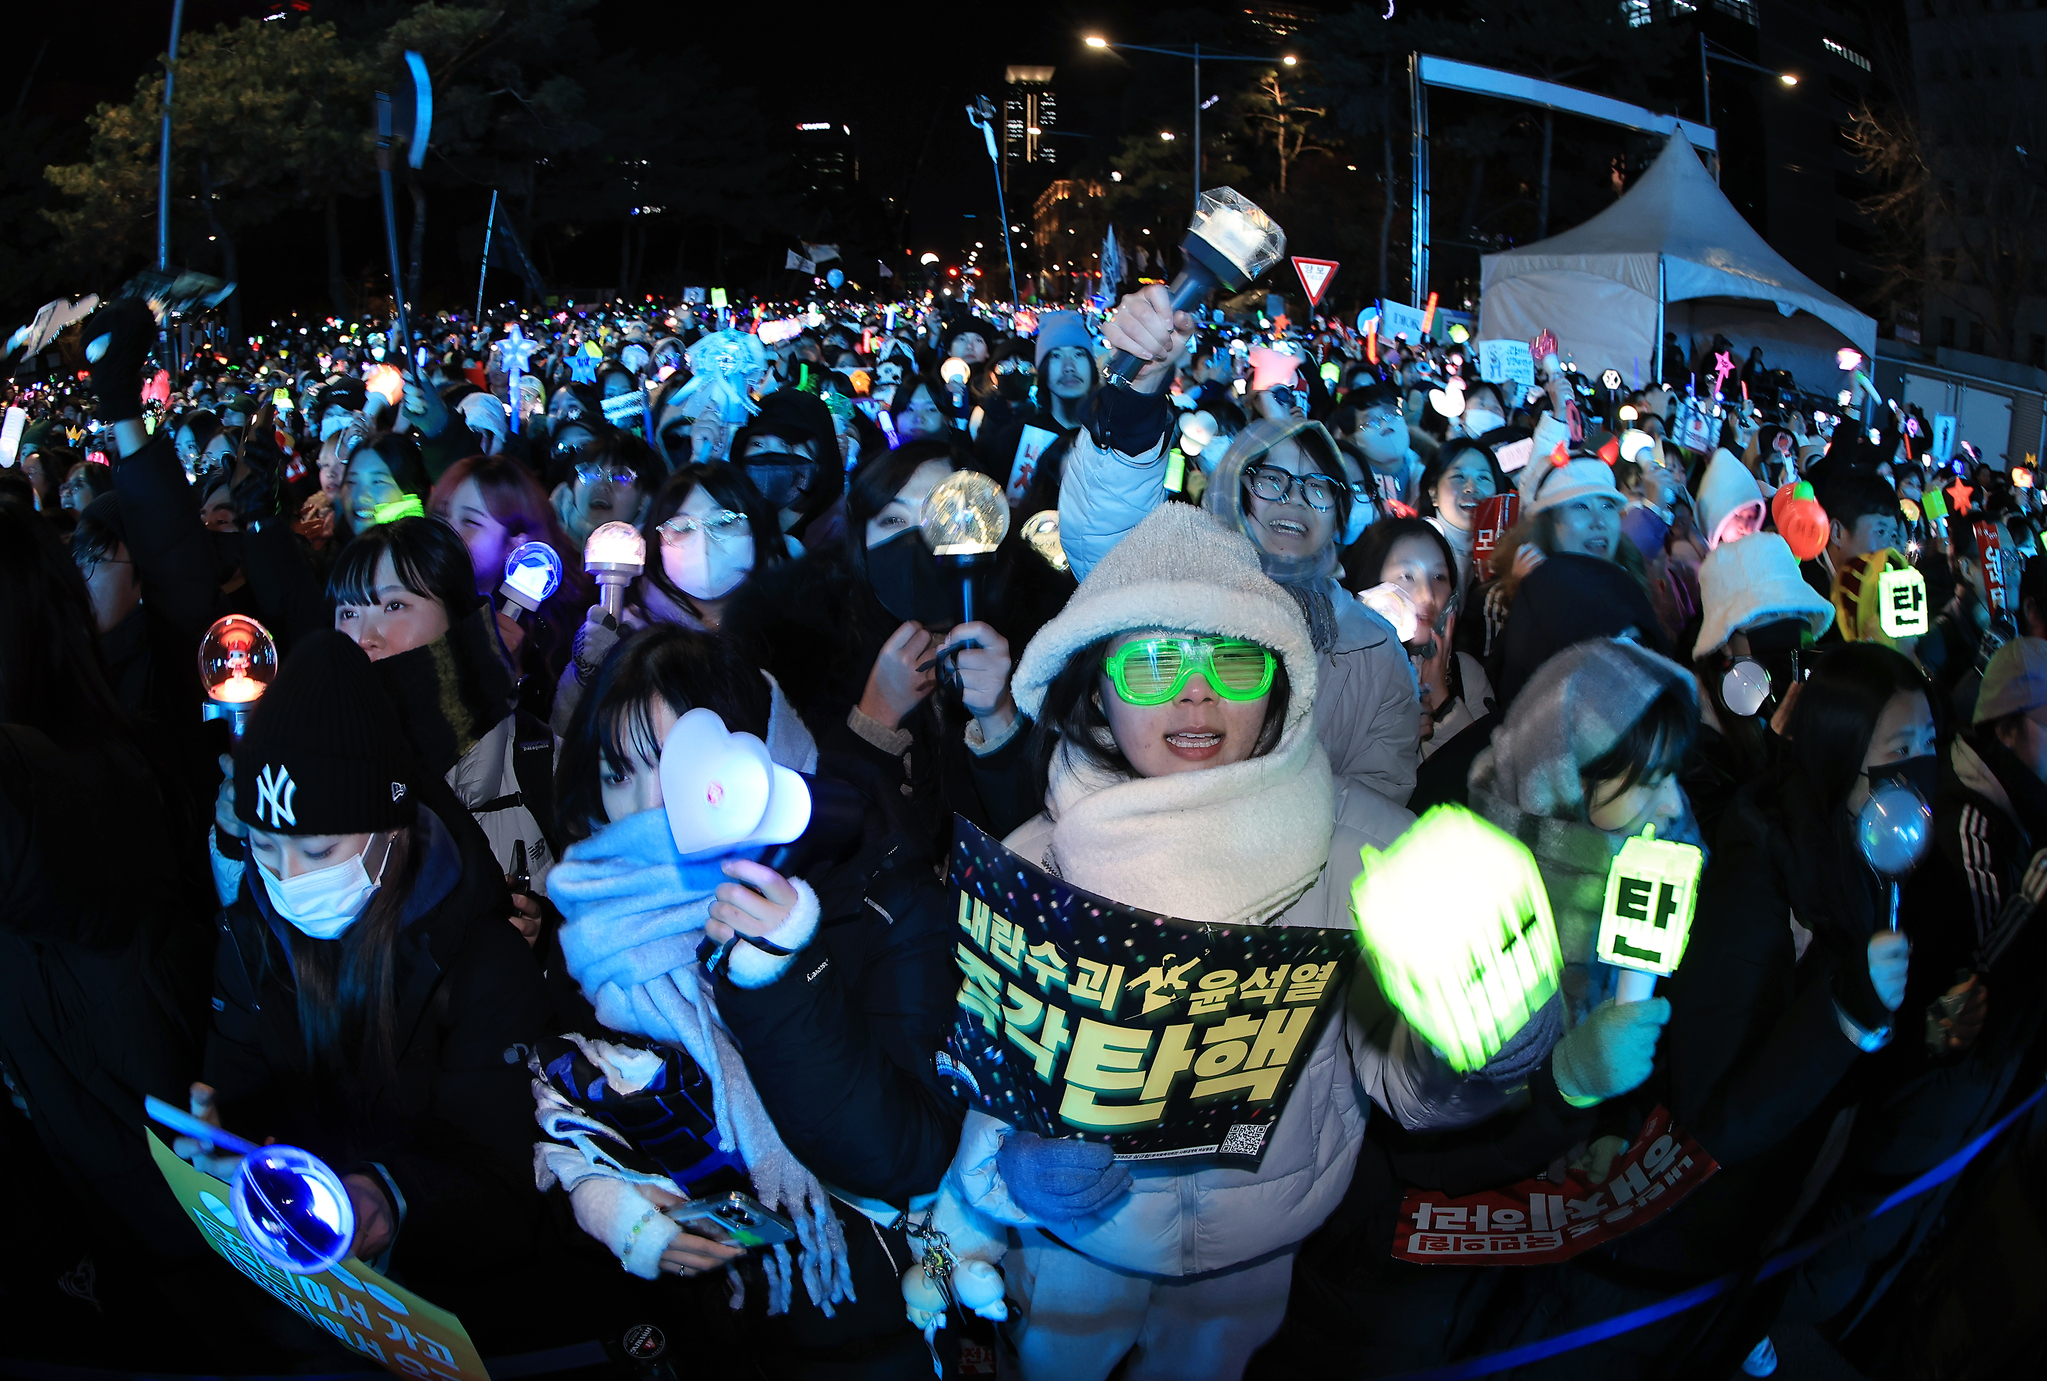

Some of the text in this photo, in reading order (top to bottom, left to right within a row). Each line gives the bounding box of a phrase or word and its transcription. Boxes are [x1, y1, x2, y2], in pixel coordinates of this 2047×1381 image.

[255, 763, 297, 829] NY
[957, 890, 1337, 1016] 내란수괴 윤석열
[1613, 876, 1677, 963] 탄
[1412, 1134, 1682, 1231] 해체하라
[1419, 1233, 1558, 1253] 국민의힘
[298, 1276, 373, 1331] 어서
[377, 1311, 460, 1372] 가고
[317, 1313, 388, 1364] 어서
